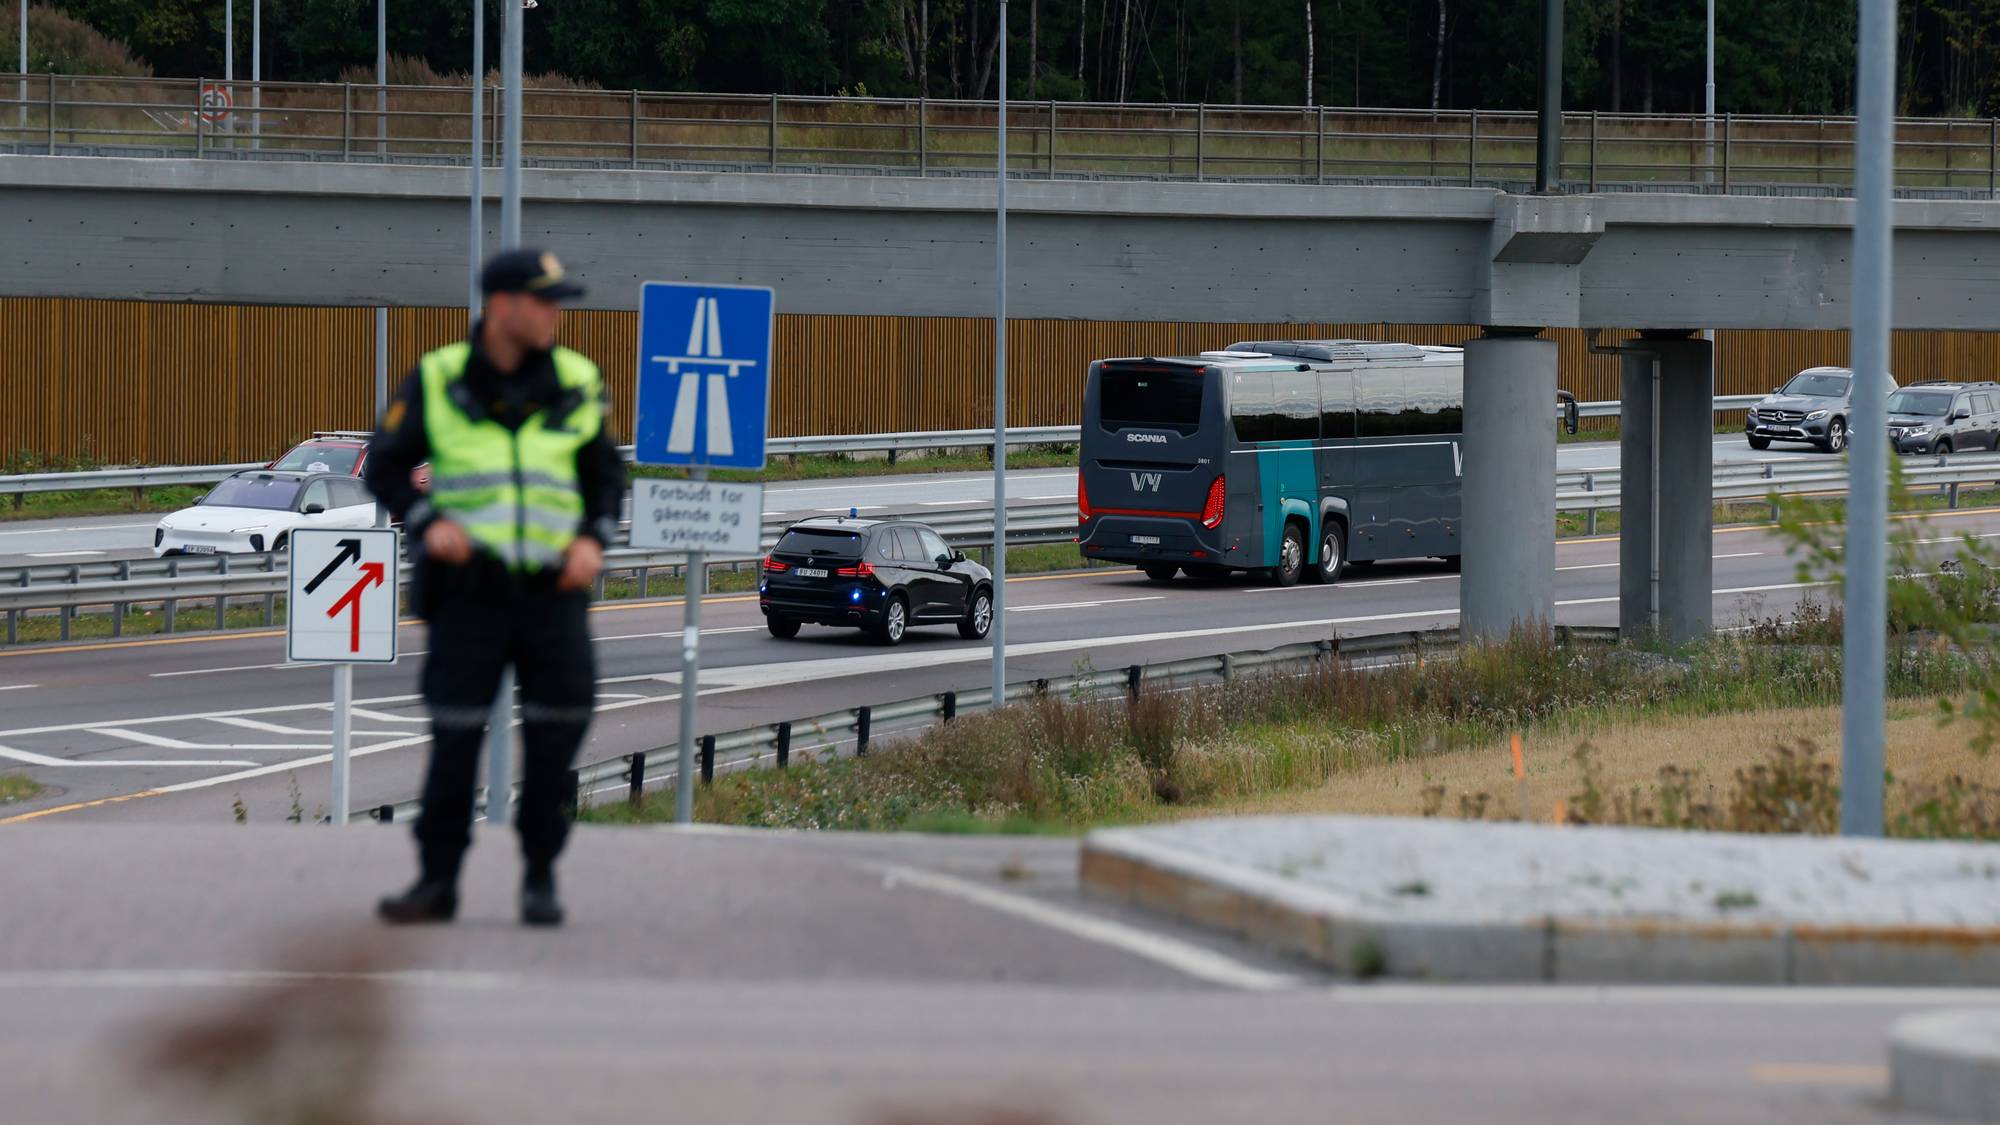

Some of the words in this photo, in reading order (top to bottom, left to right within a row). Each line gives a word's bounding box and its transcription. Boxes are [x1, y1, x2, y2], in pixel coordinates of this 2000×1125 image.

[1126, 433, 1167, 443] SCANIA
[649, 484, 711, 502] Forbudt
[720, 488, 744, 503] for
[653, 504, 711, 524] gående
[720, 511, 740, 527] og
[661, 526, 730, 543] syklende
